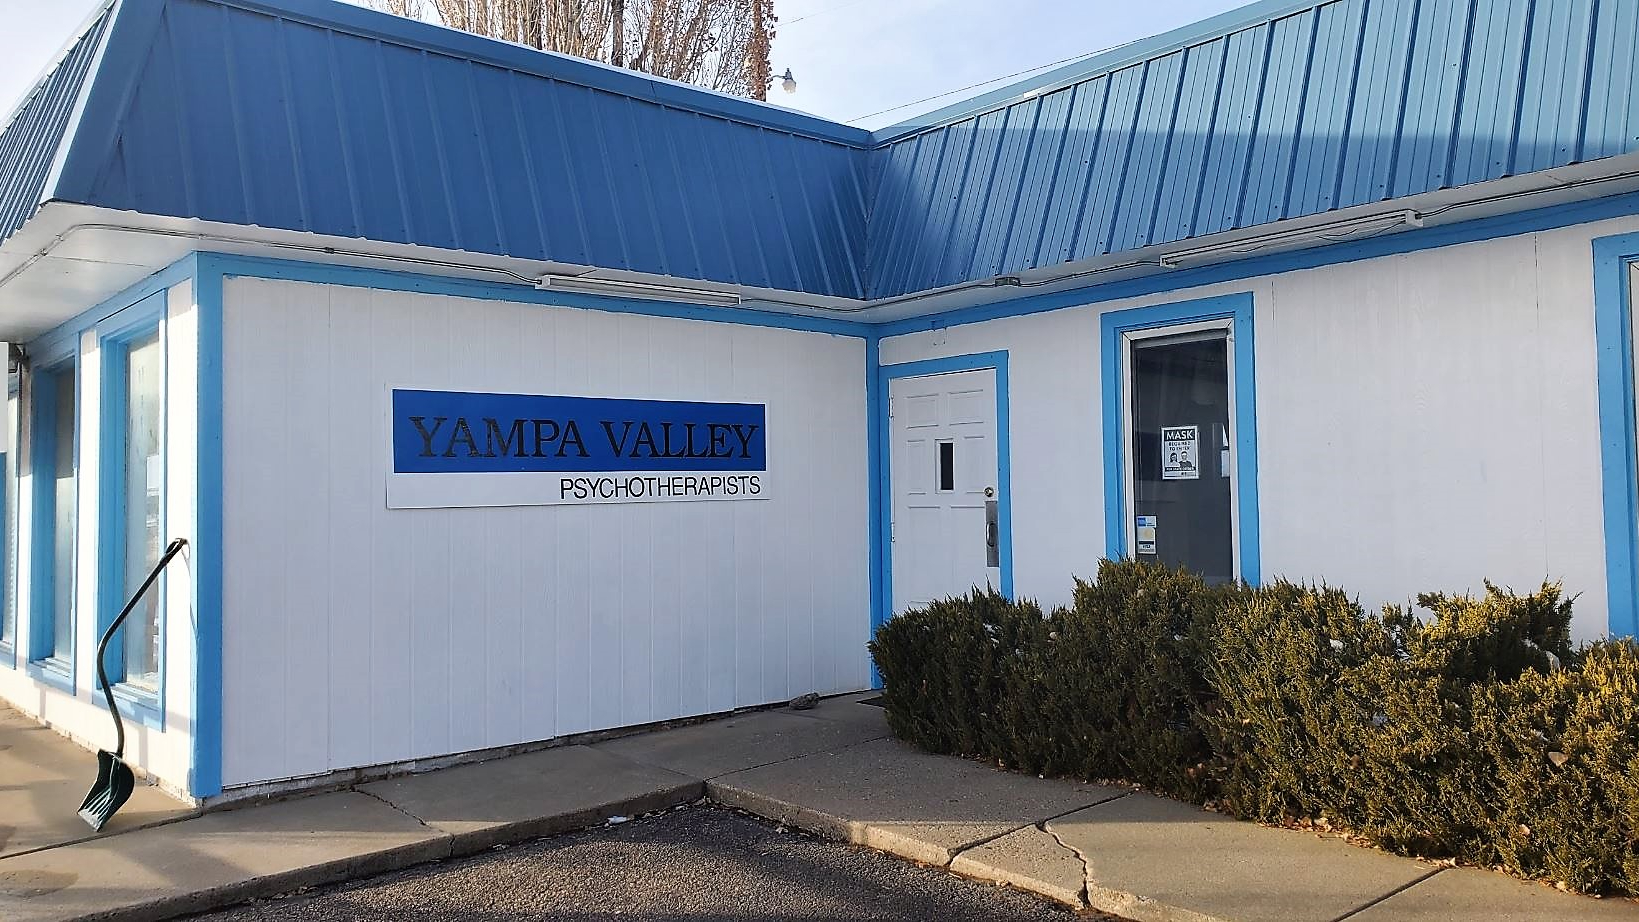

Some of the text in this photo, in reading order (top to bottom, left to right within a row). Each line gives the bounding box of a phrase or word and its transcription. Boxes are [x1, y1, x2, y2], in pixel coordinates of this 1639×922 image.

[409, 416, 760, 459] YAMPA VALLEY
[1166, 430, 1193, 440] MASK
[560, 475, 761, 500] PSYCHOTHERAPISTS
